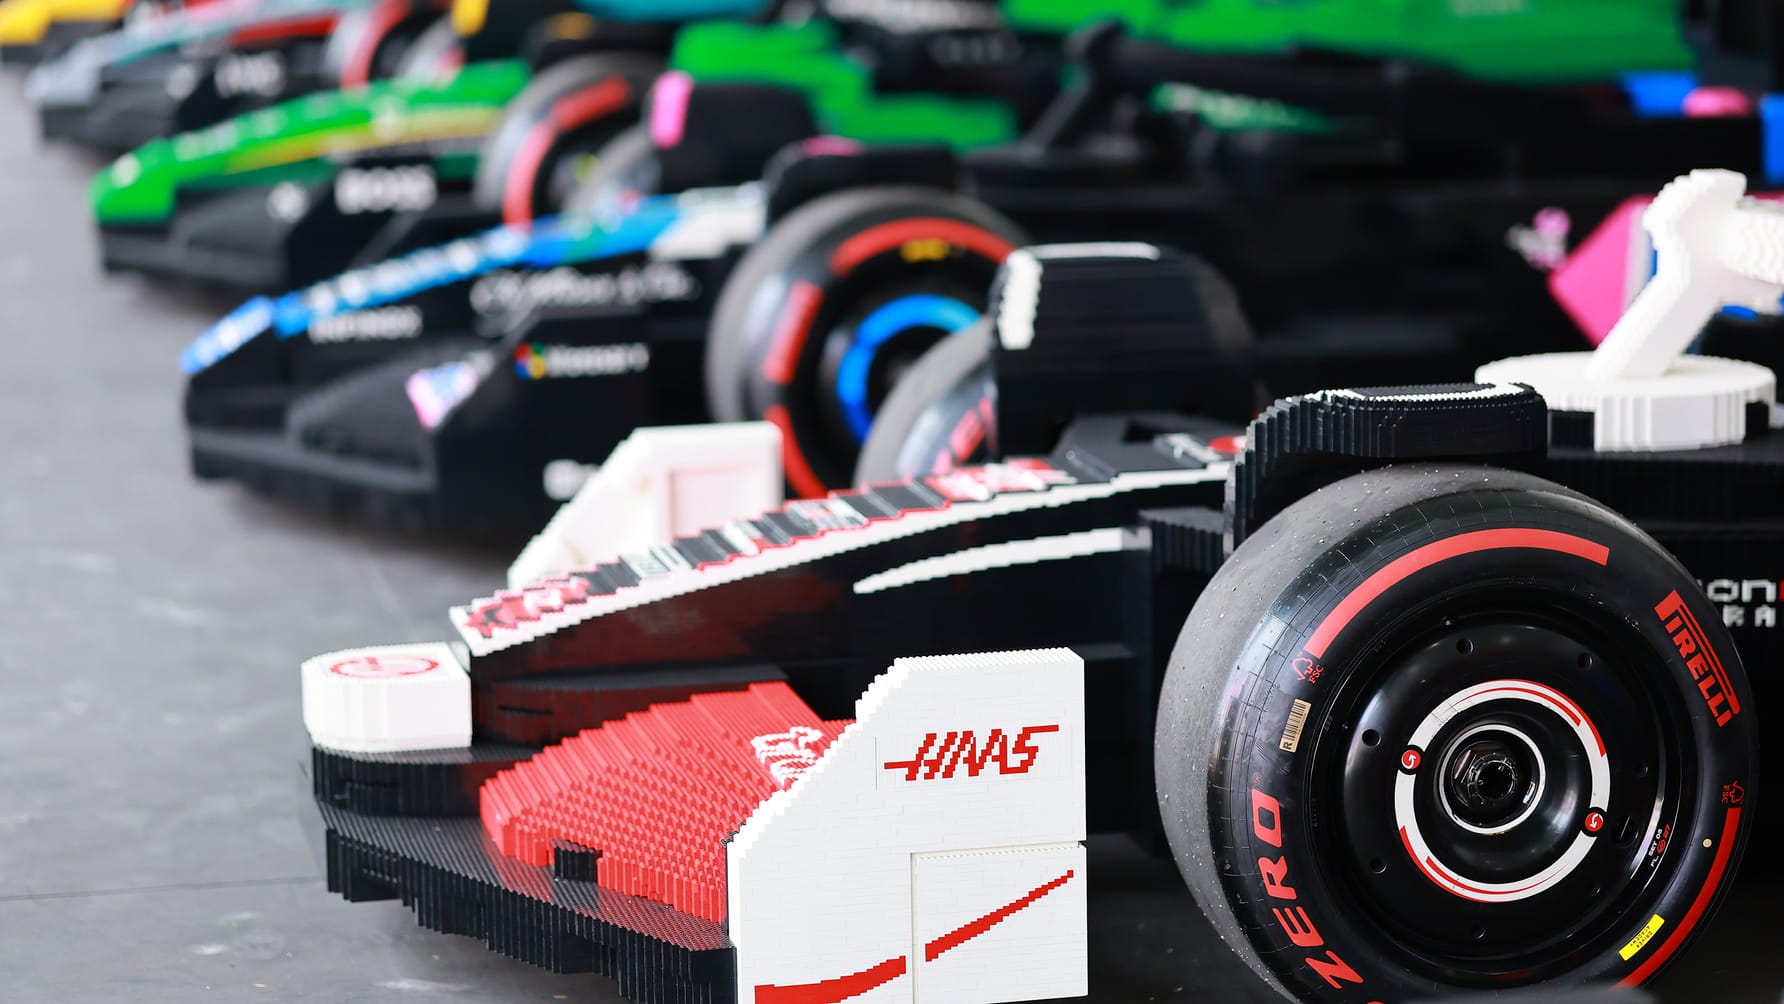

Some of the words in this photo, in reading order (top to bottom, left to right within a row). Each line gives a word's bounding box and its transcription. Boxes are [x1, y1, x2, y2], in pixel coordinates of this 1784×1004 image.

[1696, 578, 1784, 602] on
[1308, 664, 1324, 685] FSC
[1654, 589, 1741, 728] PIRELLI
[884, 724, 1059, 781] HAAS
[1283, 741, 1293, 750] R
[1251, 788, 1364, 989] ZERO
